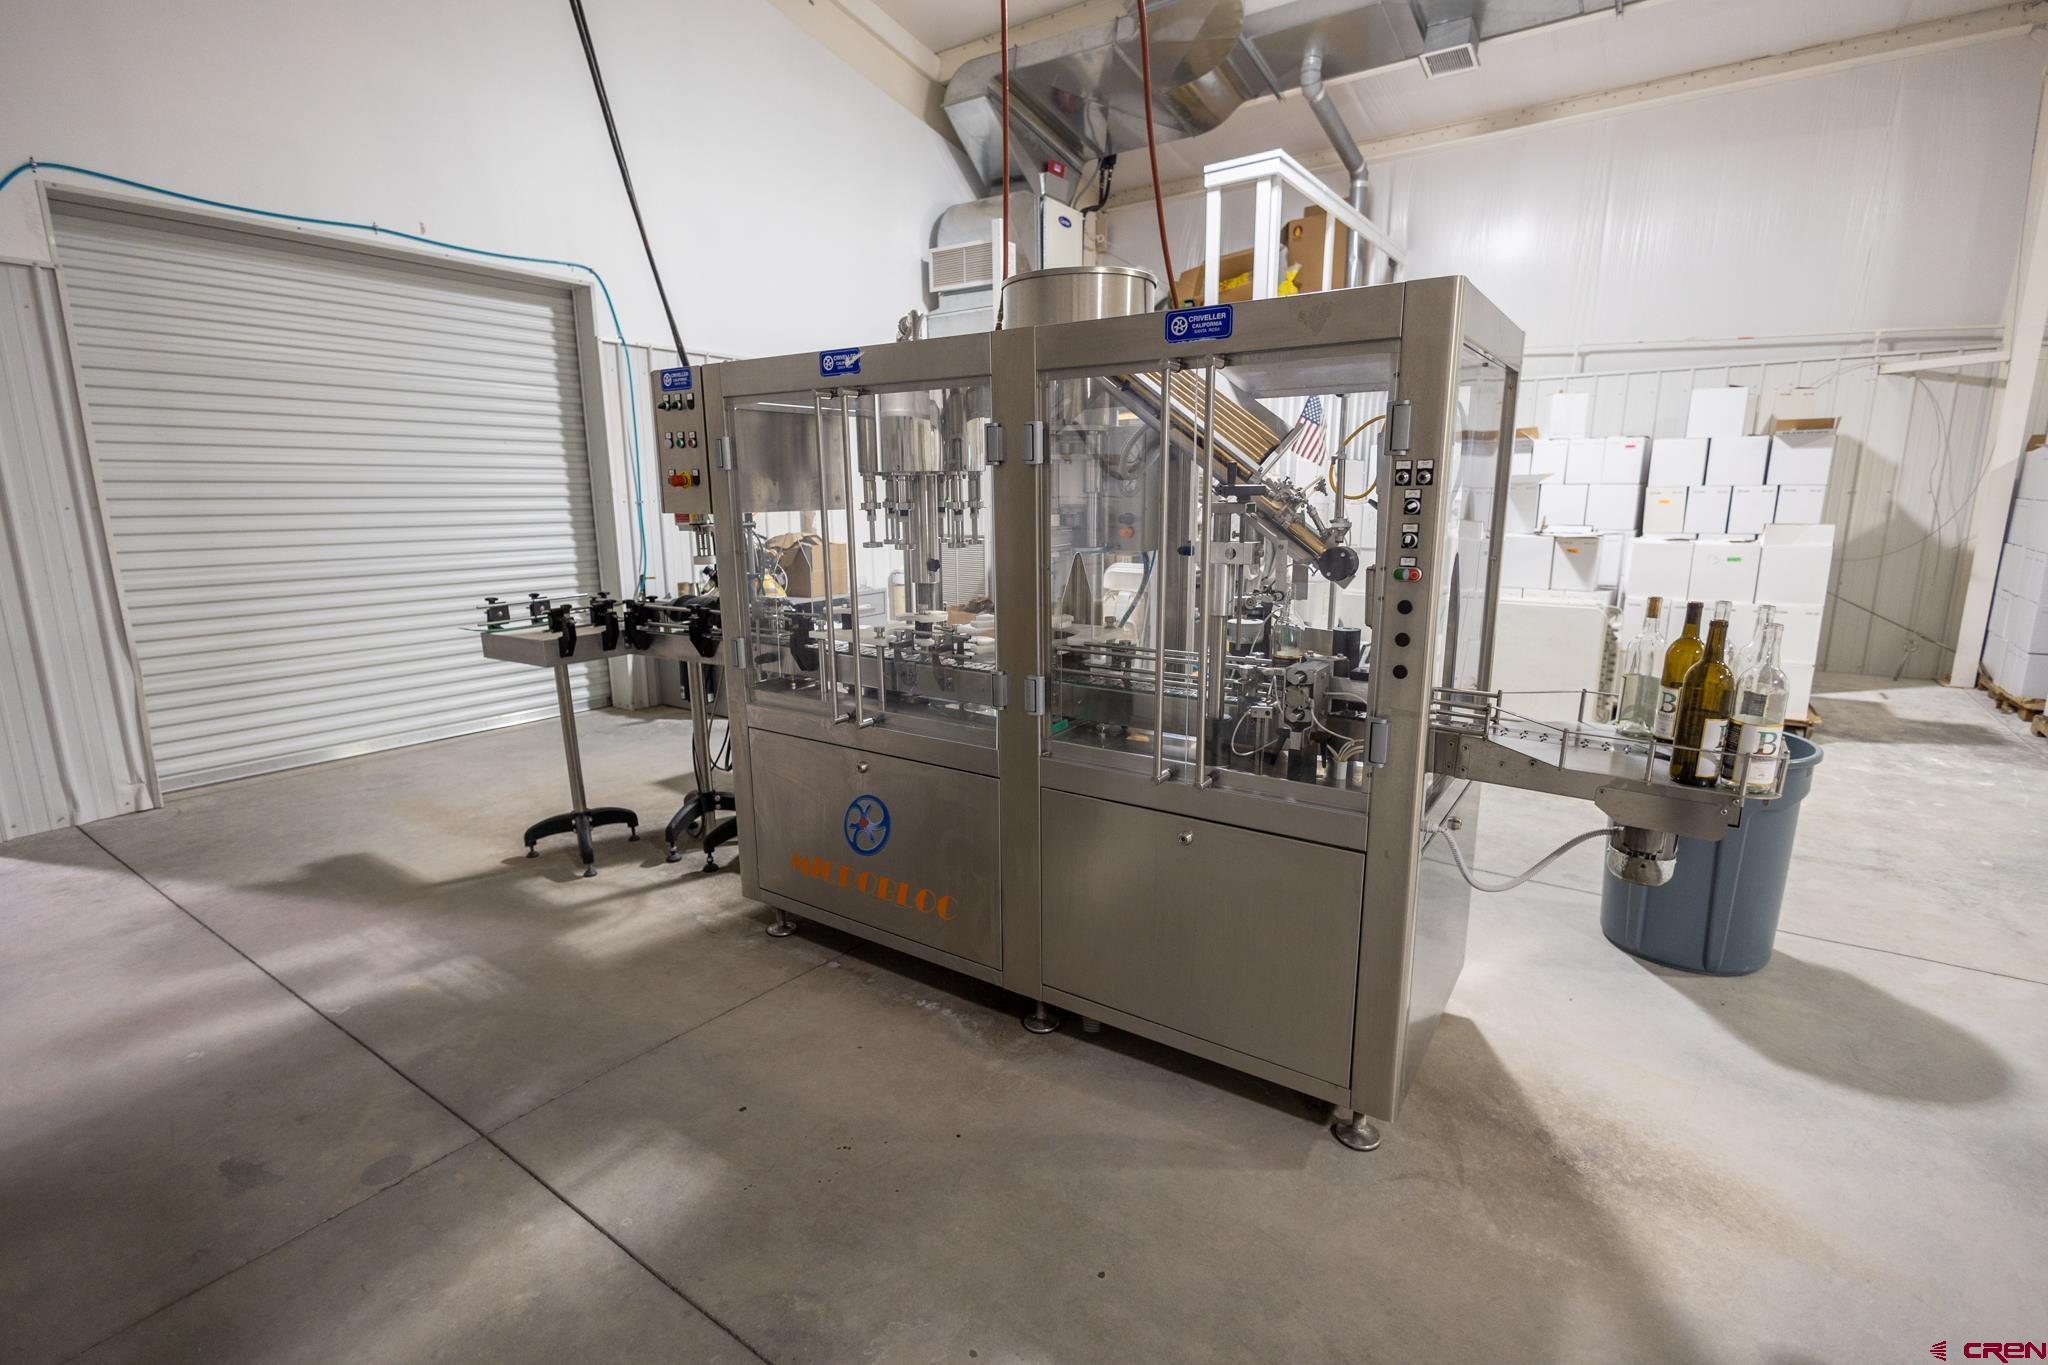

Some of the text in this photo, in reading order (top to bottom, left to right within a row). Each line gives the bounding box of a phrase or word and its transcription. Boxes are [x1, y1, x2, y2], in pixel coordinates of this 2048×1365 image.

[1188, 312, 1227, 323] CRIVELLER
[1191, 320, 1223, 329] CALIFORNIA
[1659, 691, 1677, 713] B
[1753, 730, 1778, 756] B
